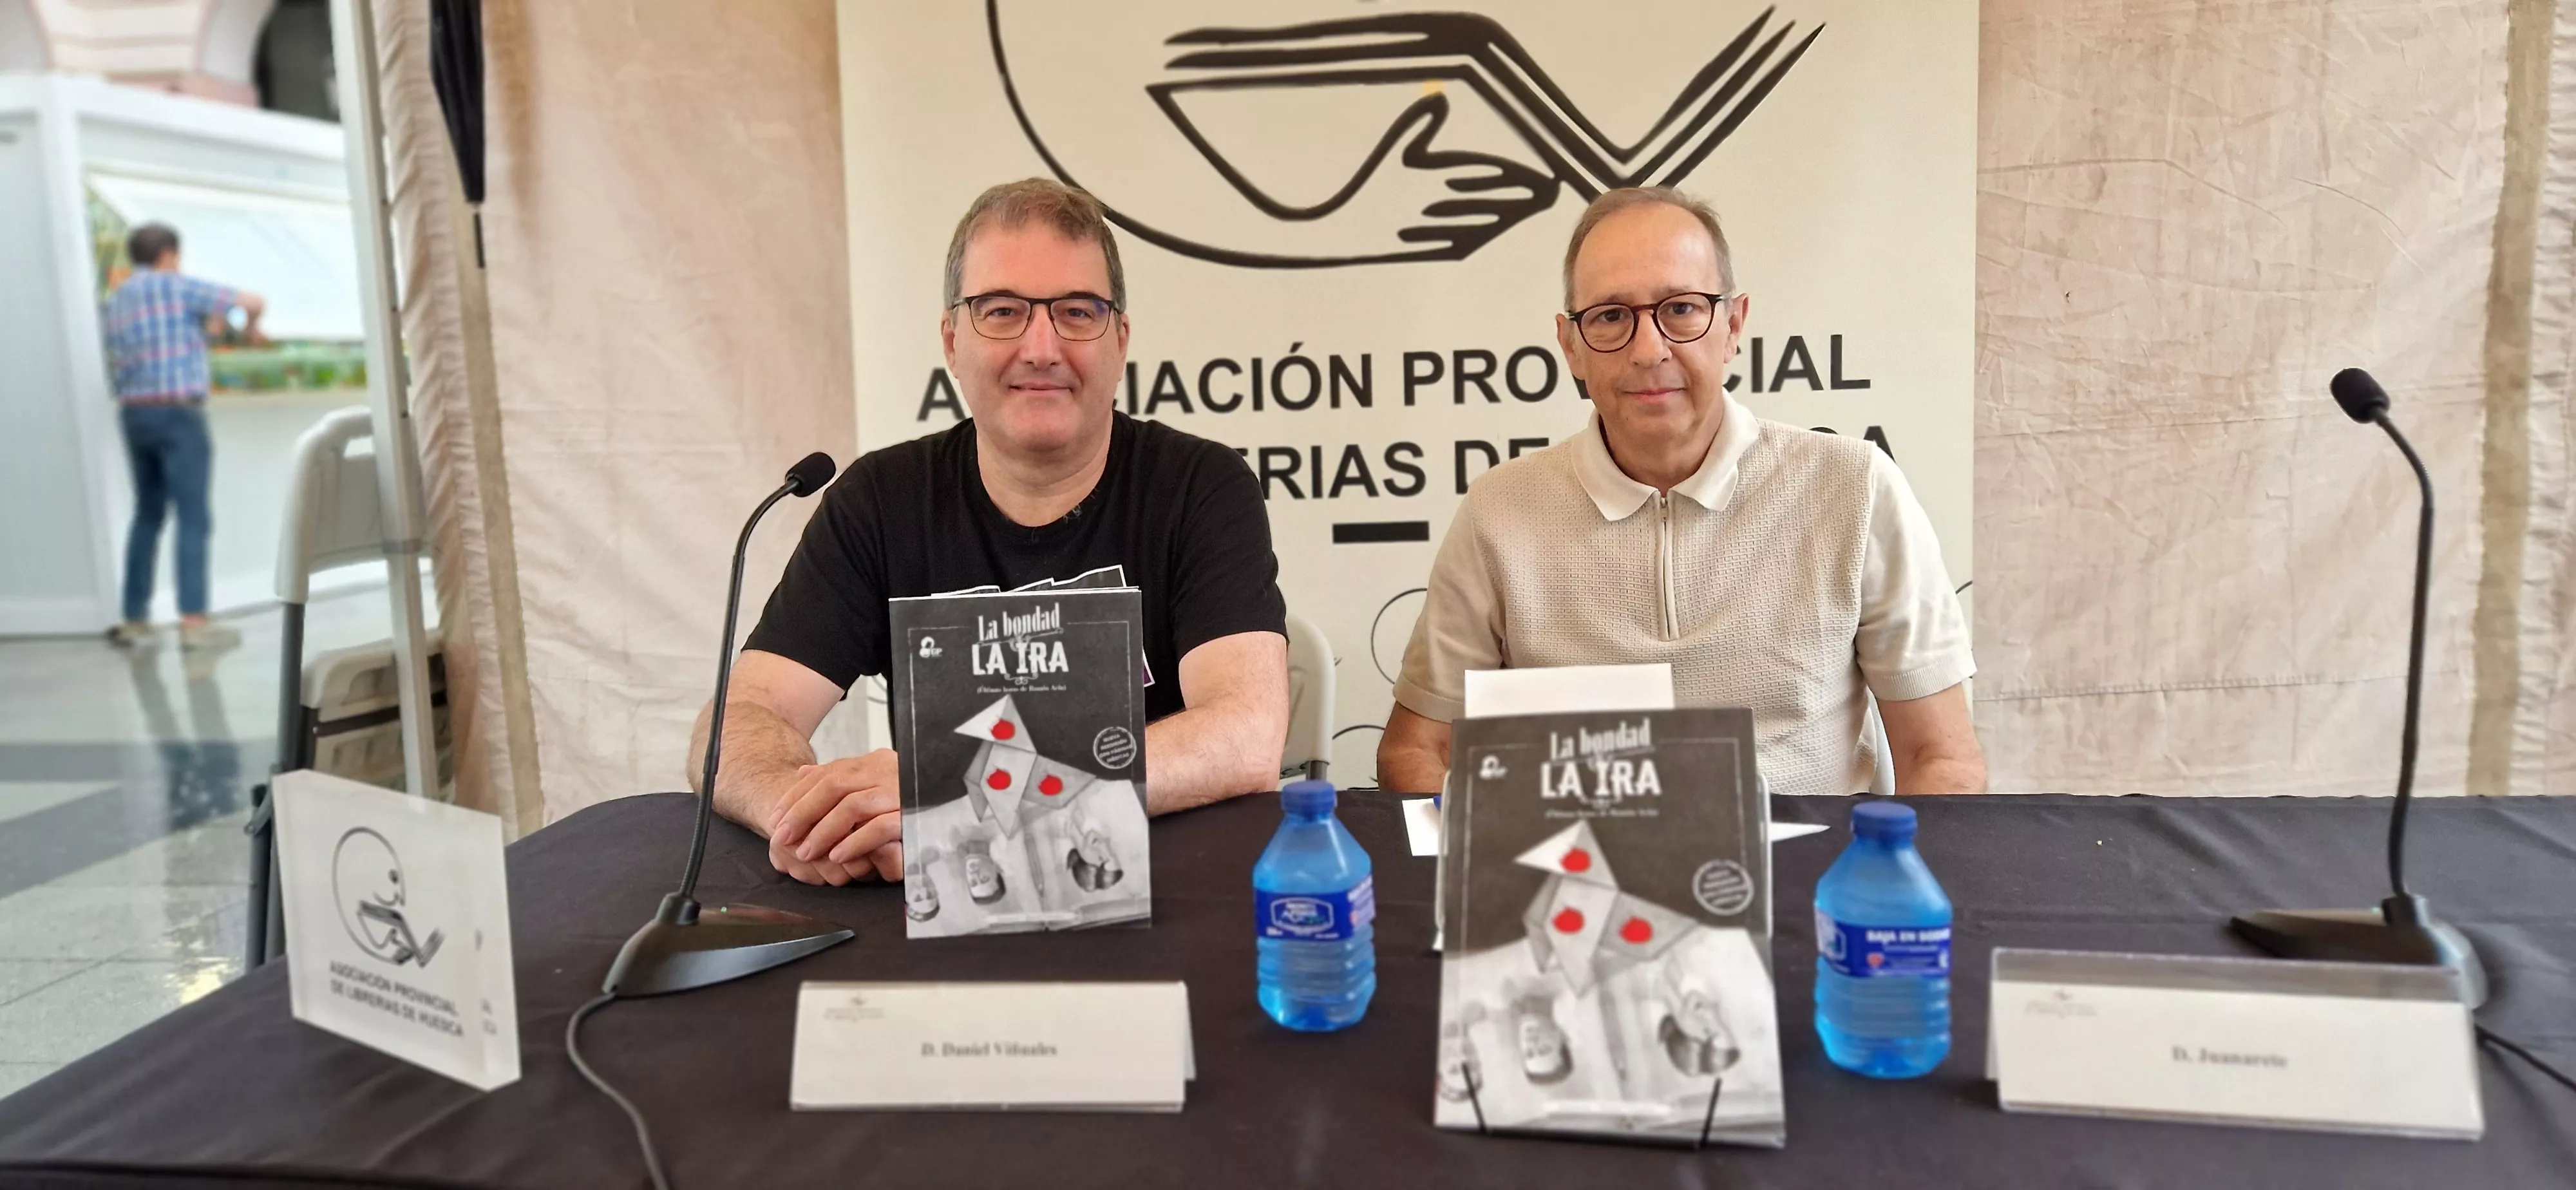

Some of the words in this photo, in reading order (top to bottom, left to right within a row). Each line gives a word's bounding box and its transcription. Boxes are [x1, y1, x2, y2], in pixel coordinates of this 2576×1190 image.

[917, 342, 1373, 422] AIACIÓN
[978, 614, 999, 641] La
[1003, 601, 1061, 637] bondad
[972, 643, 1007, 675] LA
[1015, 641, 1069, 674] IRA
[1550, 732, 1575, 760] La
[1580, 717, 1651, 755] bondad
[1540, 760, 1583, 798] LA
[1593, 758, 1662, 797] IRA
[330, 960, 392, 992] ASOCIACIÓN
[393, 981, 460, 1017] PROVINCIAL
[330, 978, 345, 996] DE
[401, 1003, 416, 1023] DE
[419, 1010, 464, 1037] HUESCA
